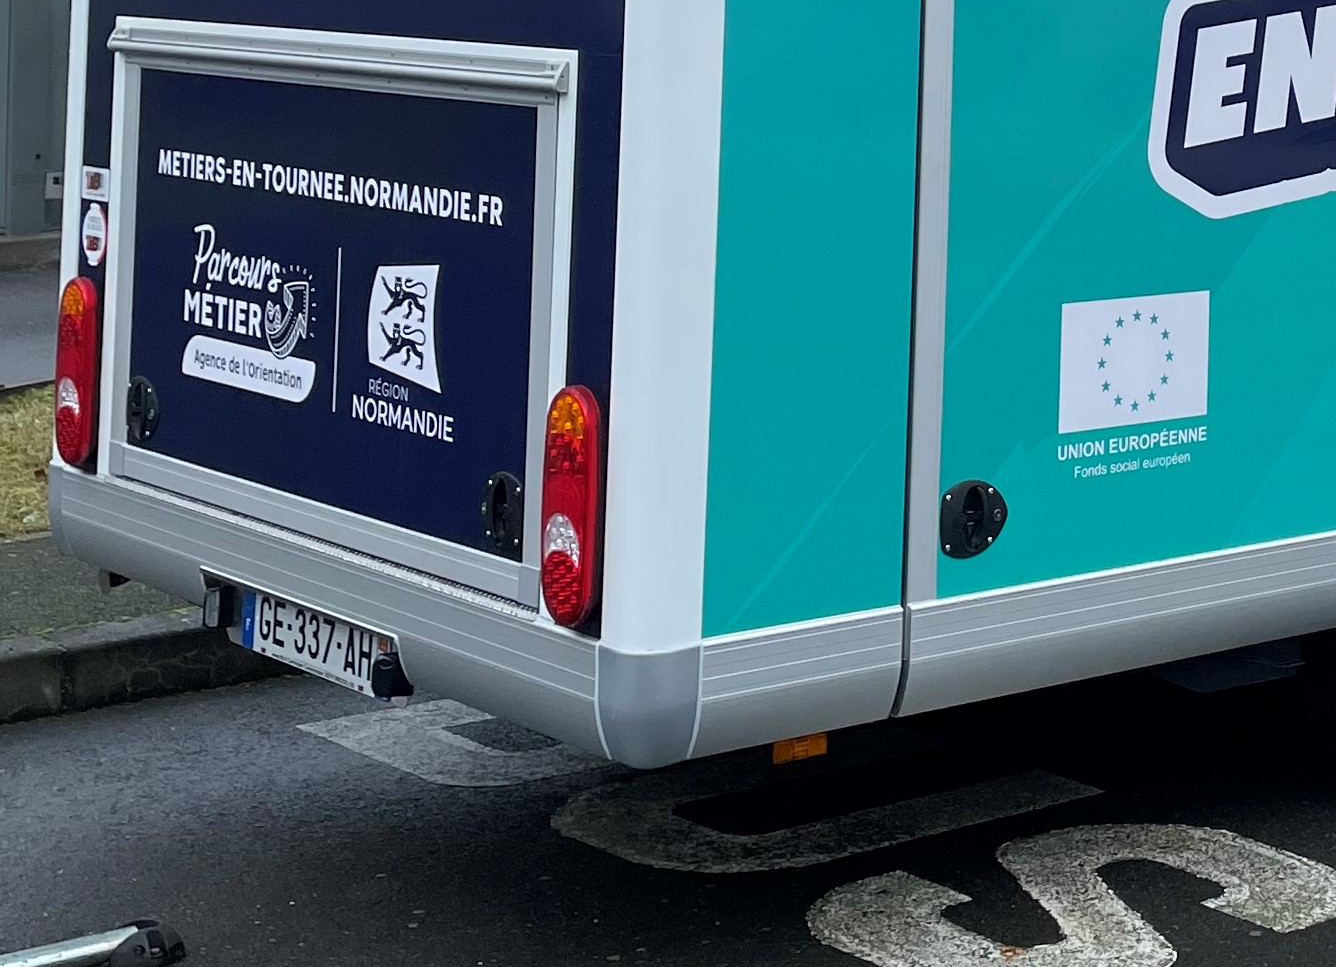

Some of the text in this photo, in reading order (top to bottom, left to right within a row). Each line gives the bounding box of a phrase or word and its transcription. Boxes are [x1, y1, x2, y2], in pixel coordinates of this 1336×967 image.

[158, 149, 504, 226] METIERS-EN-TOURNEE.NORMANDIE.FR
[193, 224, 283, 293] Parcours
[183, 282, 262, 339] MÉTIER
[194, 349, 302, 390] Agence de l'Orientation
[368, 376, 409, 402] RÉGION
[352, 395, 454, 443] NORMANDIE
[1058, 425, 1207, 461] UNION EUROPÉENNE
[1074, 451, 1191, 479] Fonds social européen
[259, 597, 373, 681] GE-337-AH
